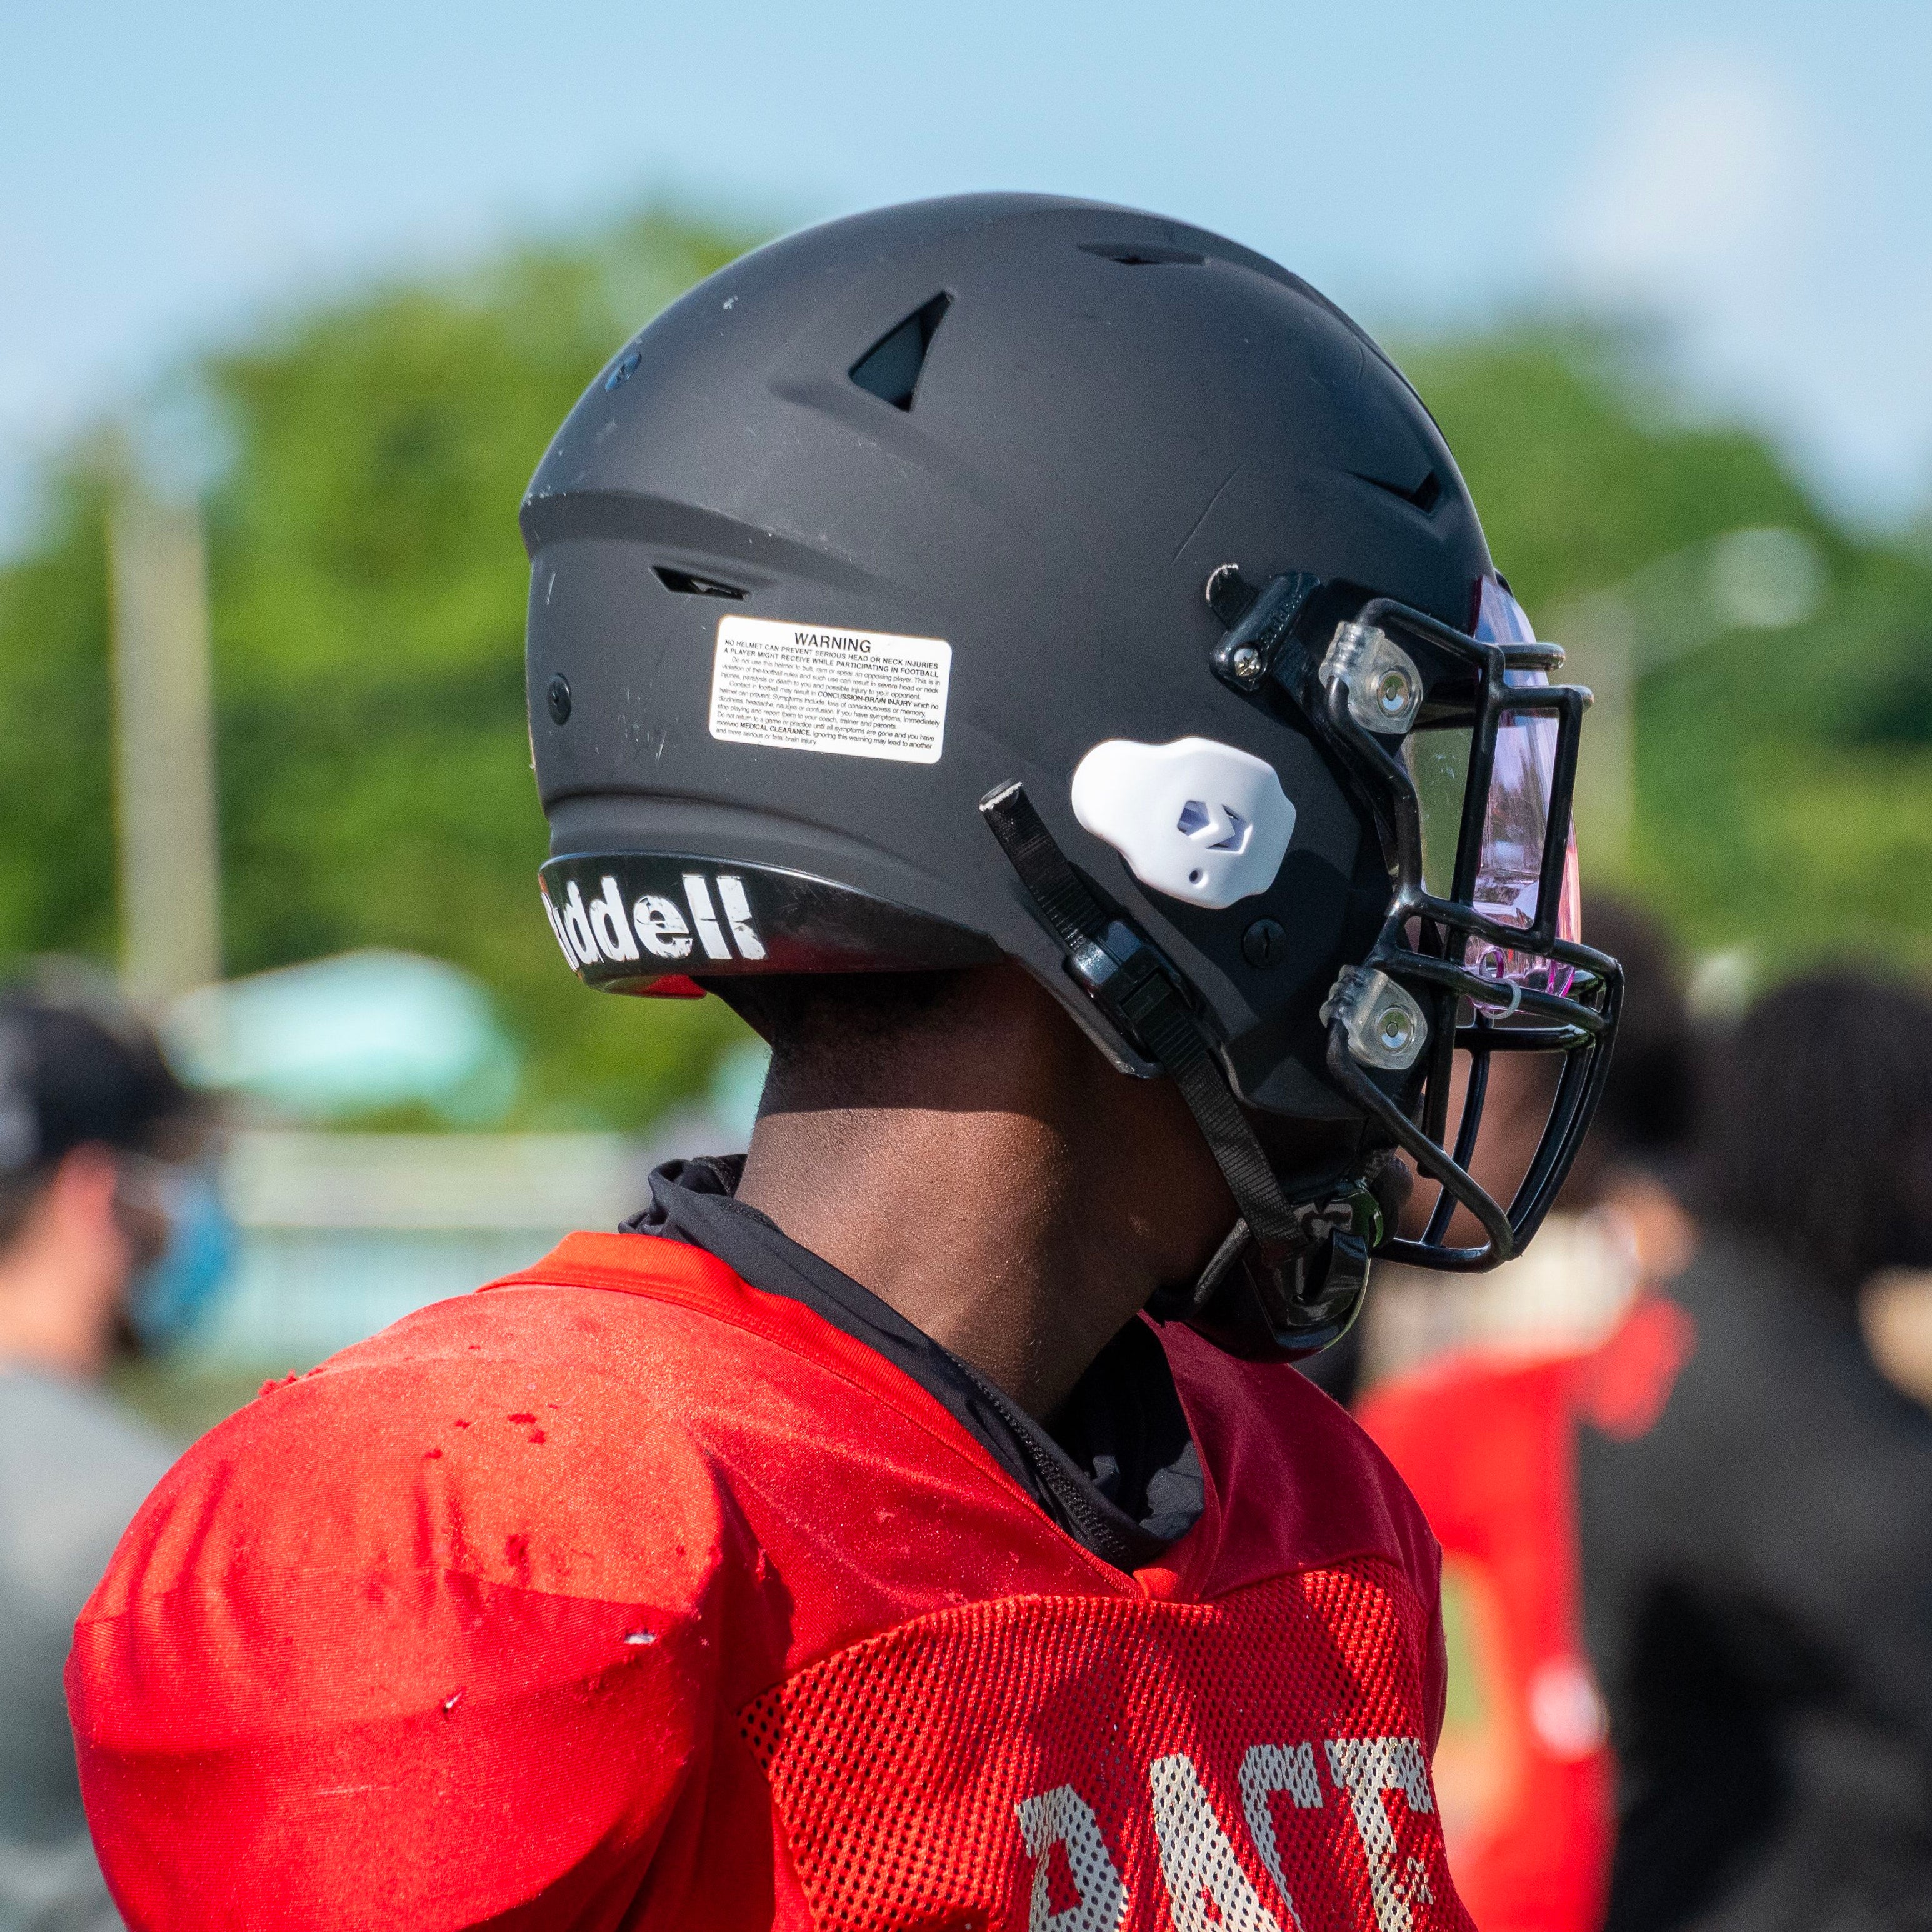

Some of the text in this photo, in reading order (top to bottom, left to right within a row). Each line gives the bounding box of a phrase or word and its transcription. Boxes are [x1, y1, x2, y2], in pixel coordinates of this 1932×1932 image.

[736, 641, 762, 649] HELMET
[781, 646, 812, 654] PREVENT
[815, 650, 846, 659] SERIOUS
[905, 660, 938, 669] INJURIES
[795, 632, 871, 653] WARNING
[730, 648, 755, 656] PLAYER
[781, 654, 810, 663] RECEIVE
[836, 661, 888, 671] PARTICIPATING
[900, 668, 938, 677] FOOTBALL
